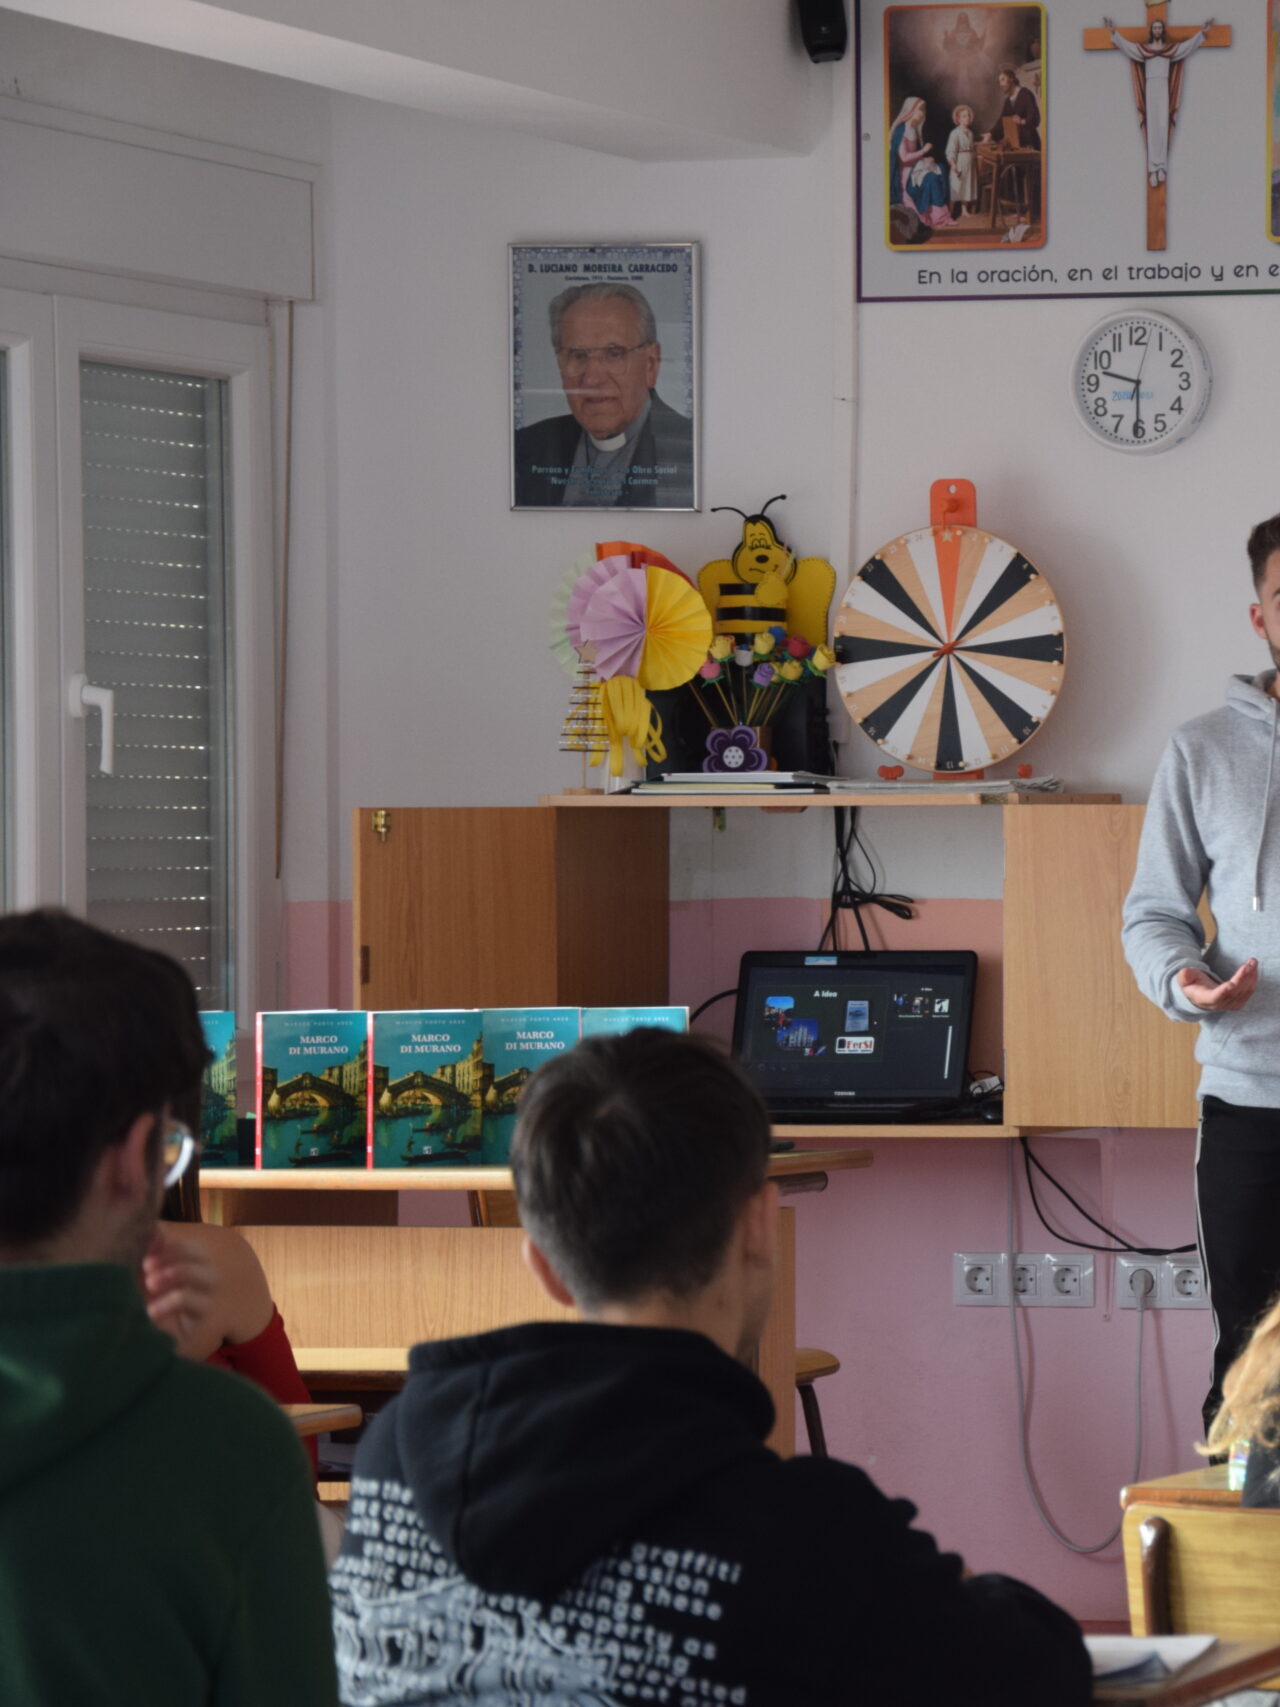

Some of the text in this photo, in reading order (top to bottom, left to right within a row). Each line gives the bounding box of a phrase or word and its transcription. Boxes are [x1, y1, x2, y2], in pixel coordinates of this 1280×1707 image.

[528, 263, 678, 273] D. LUCIANO MOREIRA CARRACEDO
[917, 269, 942, 285] En
[951, 268, 968, 283] la
[977, 264, 1058, 284] oración,
[1067, 267, 1093, 282] en
[1102, 265, 1118, 281] el
[1128, 263, 1201, 282] trabajo
[1211, 265, 1224, 282] y
[1233, 264, 1259, 278] en
[1112, 332, 1122, 352] 11
[1129, 326, 1147, 346] 12
[1159, 332, 1163, 352] 1
[1094, 350, 1112, 370] 10
[1170, 348, 1184, 368] 2
[1086, 374, 1100, 393] 9
[1178, 371, 1192, 391] 3
[1094, 397, 1108, 417] 8
[1169, 396, 1184, 415] 4
[1111, 414, 1124, 433] 7
[1132, 419, 1146, 439] 6
[1154, 413, 1167, 432] 5
[300, 1035, 338, 1044] MARCO
[411, 1033, 450, 1043] MARCO
[515, 1030, 555, 1040] MARCO
[289, 1045, 349, 1056] DI MURANO
[400, 1044, 461, 1054] DI MURANO
[505, 1041, 566, 1050] DI MURANO
[631, 1542, 742, 1585] graffiti
[643, 1582, 722, 1622] these
